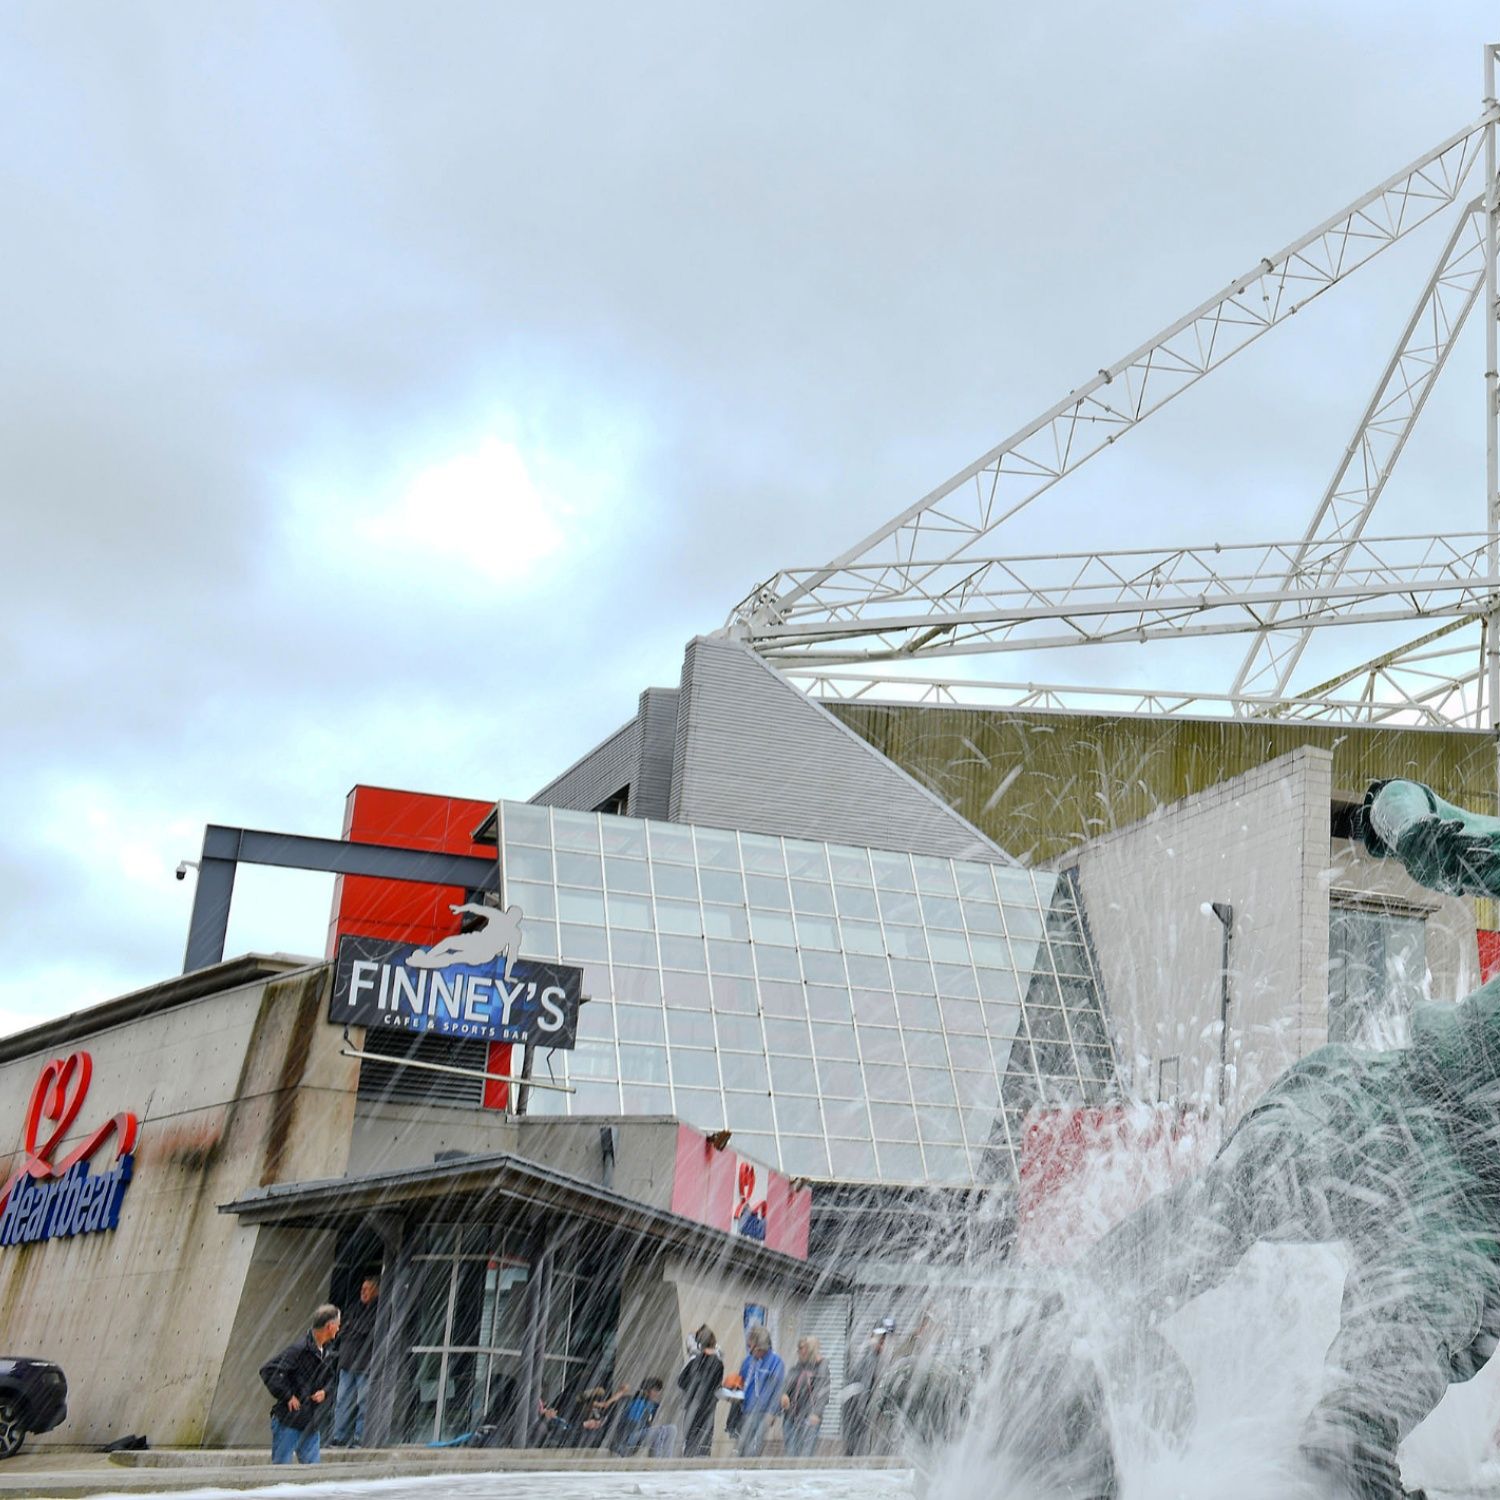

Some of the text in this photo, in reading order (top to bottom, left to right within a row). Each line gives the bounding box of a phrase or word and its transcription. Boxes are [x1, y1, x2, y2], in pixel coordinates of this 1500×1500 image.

[348, 960, 566, 1032] FINNEY'S
[384, 1014, 529, 1042] CAFE & SPORTS BAR
[0, 1153, 127, 1246] Heartbeat
